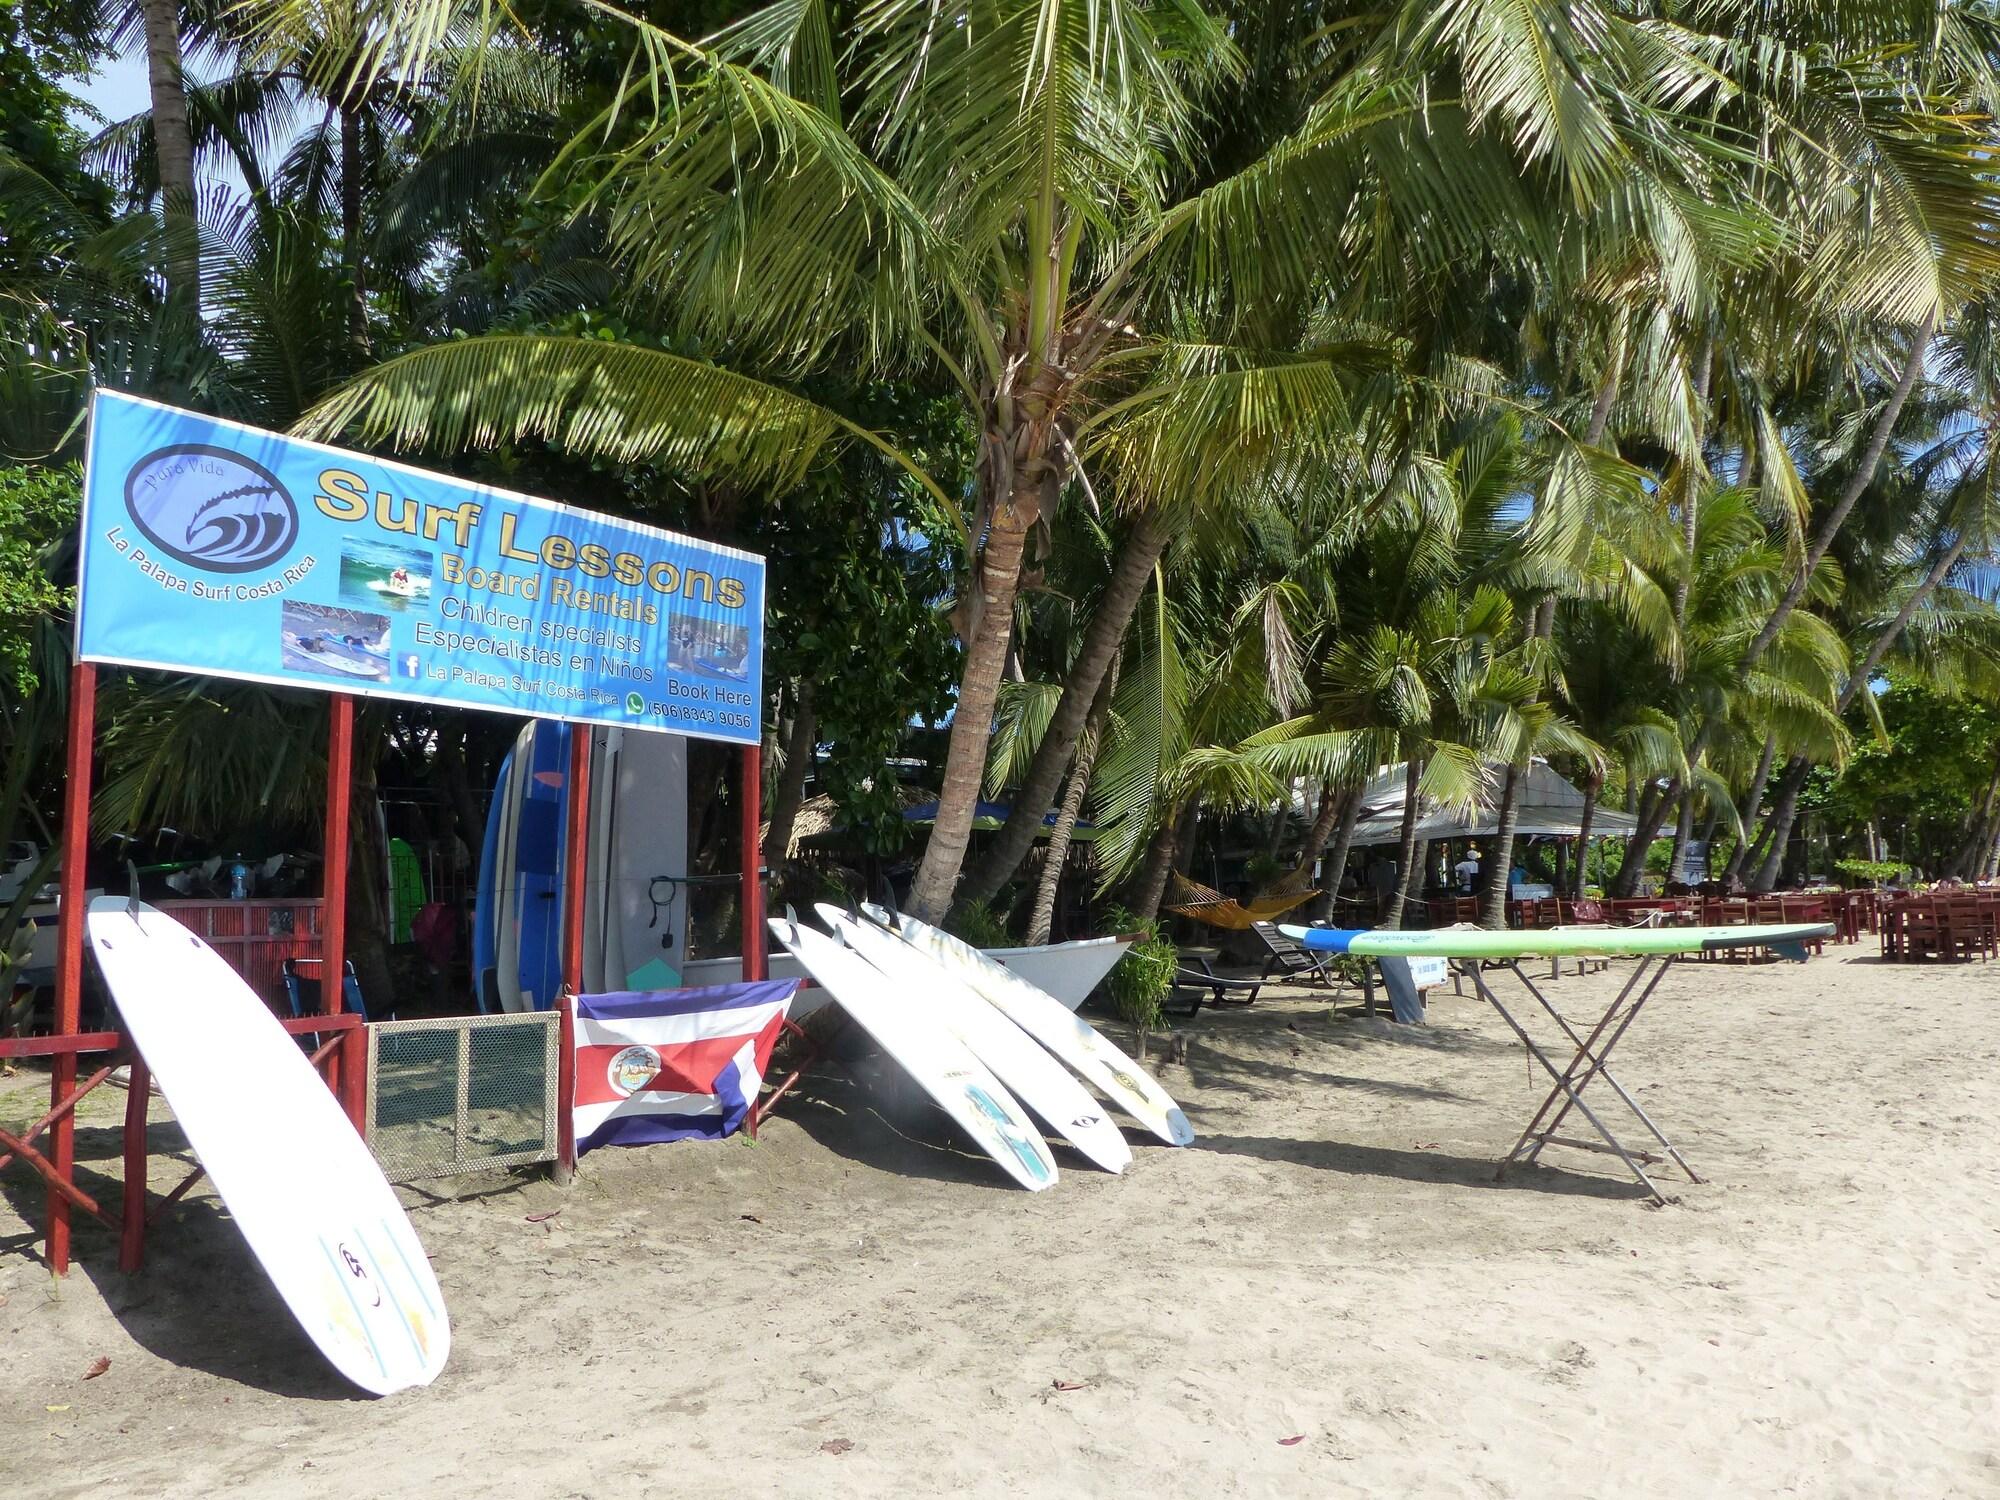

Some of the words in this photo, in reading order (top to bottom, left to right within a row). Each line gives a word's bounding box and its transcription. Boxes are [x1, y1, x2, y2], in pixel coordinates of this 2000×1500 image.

[144, 464, 184, 491] Pura
[187, 456, 225, 477] Vida
[106, 527, 129, 553] La
[129, 549, 187, 592] Palapa
[193, 581, 230, 600] Surf
[236, 579, 284, 600] Costa
[283, 555, 315, 585] Rica
[313, 468, 483, 548] Surf
[499, 512, 747, 609] Lessons
[441, 553, 540, 602] Board
[551, 576, 659, 626] Rentals
[416, 622, 562, 667] Especialistas
[570, 655, 594, 672] en
[601, 655, 653, 682] Niños
[441, 597, 532, 633] Children
[540, 621, 641, 653] specialists
[427, 664, 446, 680] La
[452, 667, 506, 689] Palapa
[512, 675, 541, 693] Surf
[546, 682, 586, 700] Costa
[591, 688, 619, 705] Rica
[668, 679, 709, 700] Book
[715, 686, 751, 706] Here
[648, 702, 715, 723] (506)8343
[720, 713, 751, 728] 9056
